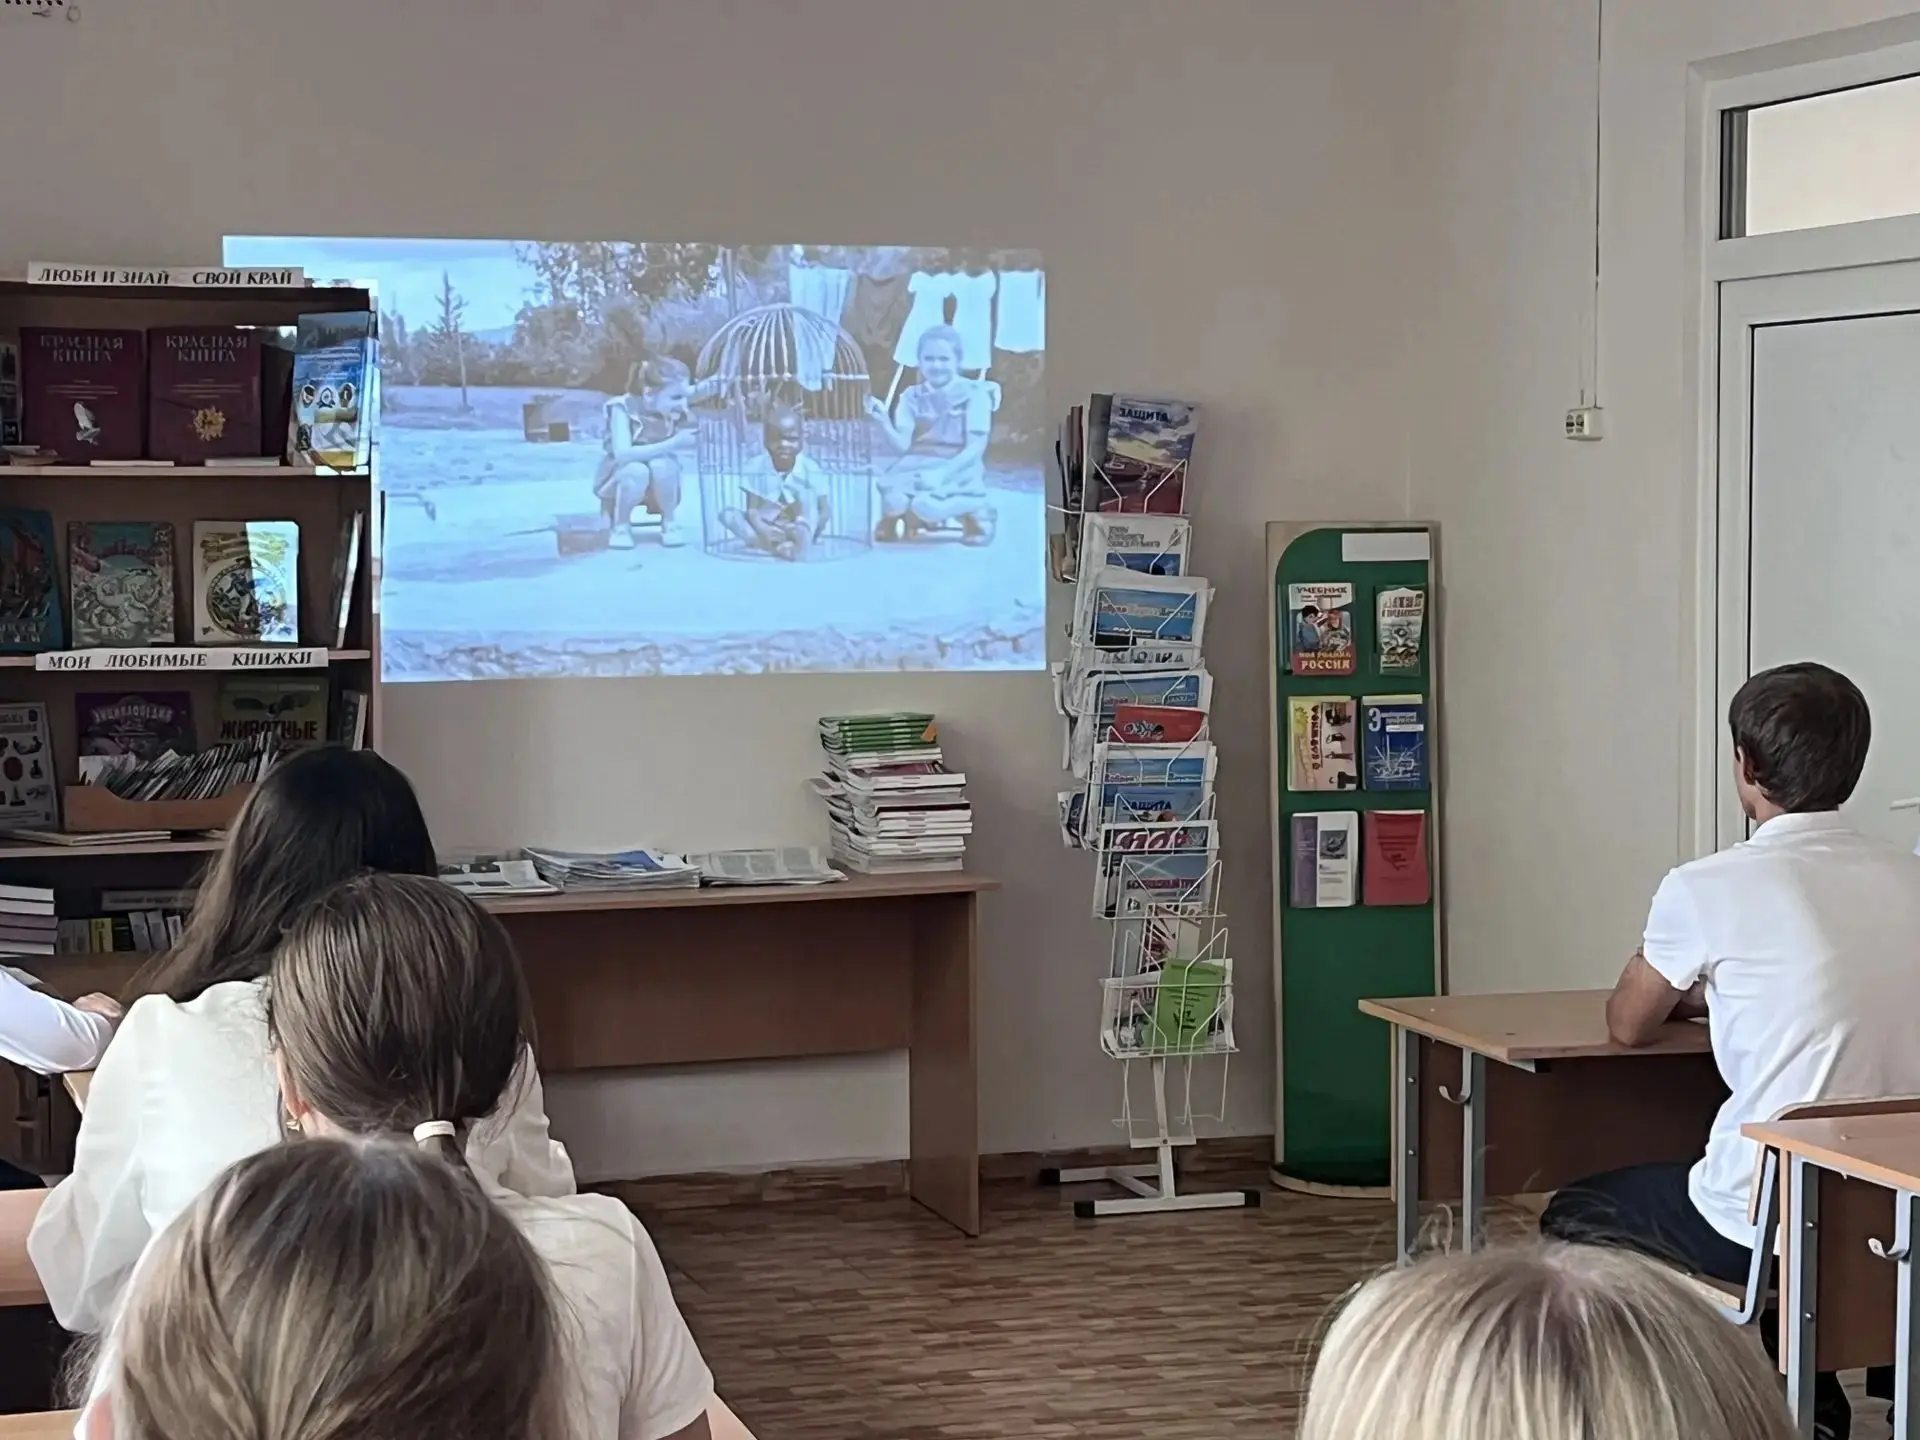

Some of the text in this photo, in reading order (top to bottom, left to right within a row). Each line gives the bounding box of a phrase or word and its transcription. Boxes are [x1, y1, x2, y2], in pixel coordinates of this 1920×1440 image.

[38, 267, 292, 285] ЛЮБИ И ЗНАЙ СВОЙ КРАЙ
[41, 335, 124, 349] КРАСНАЯ
[166, 335, 248, 349] КРАСНАЯ
[53, 349, 113, 362] КНИГА
[178, 348, 236, 362] КНИГА
[1119, 408, 1170, 423] ЗАЩИТА
[48, 651, 313, 669] МОИ ЛЮБИМЫЕ КНИЖКИ
